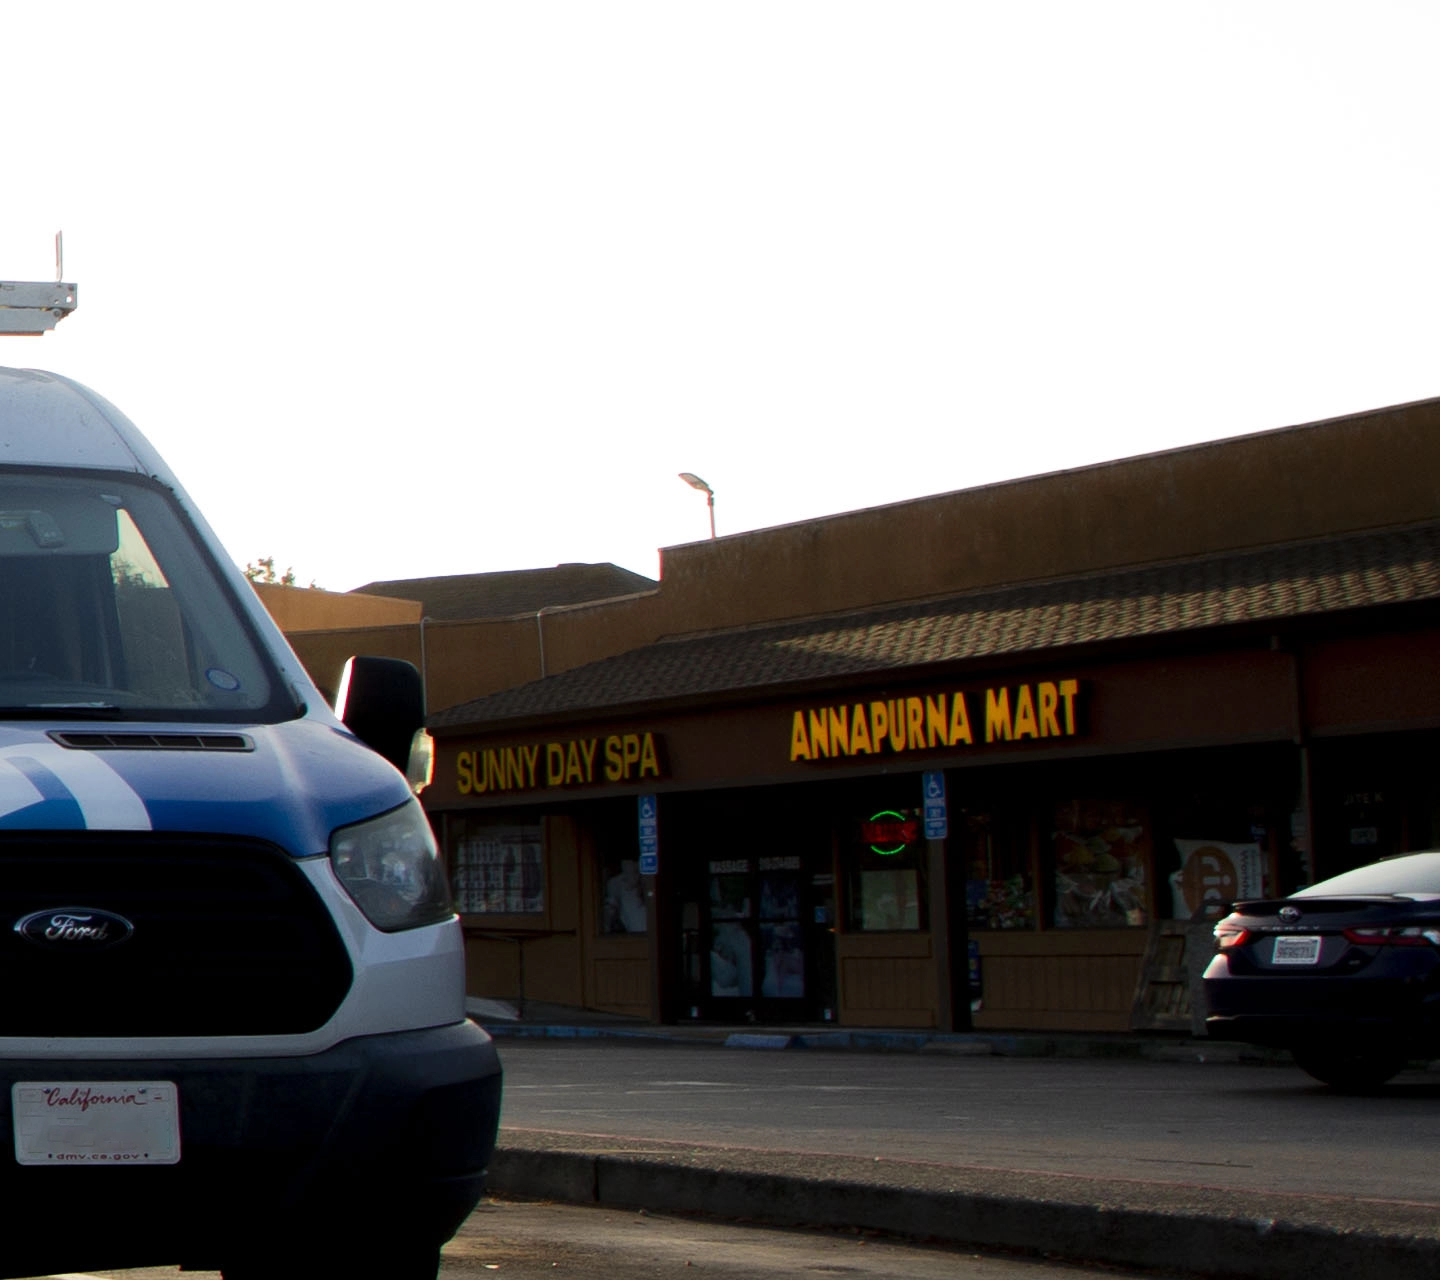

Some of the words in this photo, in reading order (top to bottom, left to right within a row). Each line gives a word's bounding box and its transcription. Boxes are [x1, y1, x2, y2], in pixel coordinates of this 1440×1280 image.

[789, 692, 973, 762] ANNAPURNA
[984, 679, 1080, 744] MART
[456, 743, 537, 795] SUNNY
[547, 738, 597, 784] DAY
[604, 731, 660, 782] SPA
[44, 914, 110, 940] Ford
[45, 1087, 147, 1111] California
[55, 1153, 140, 1162] dmv.ca.gov
